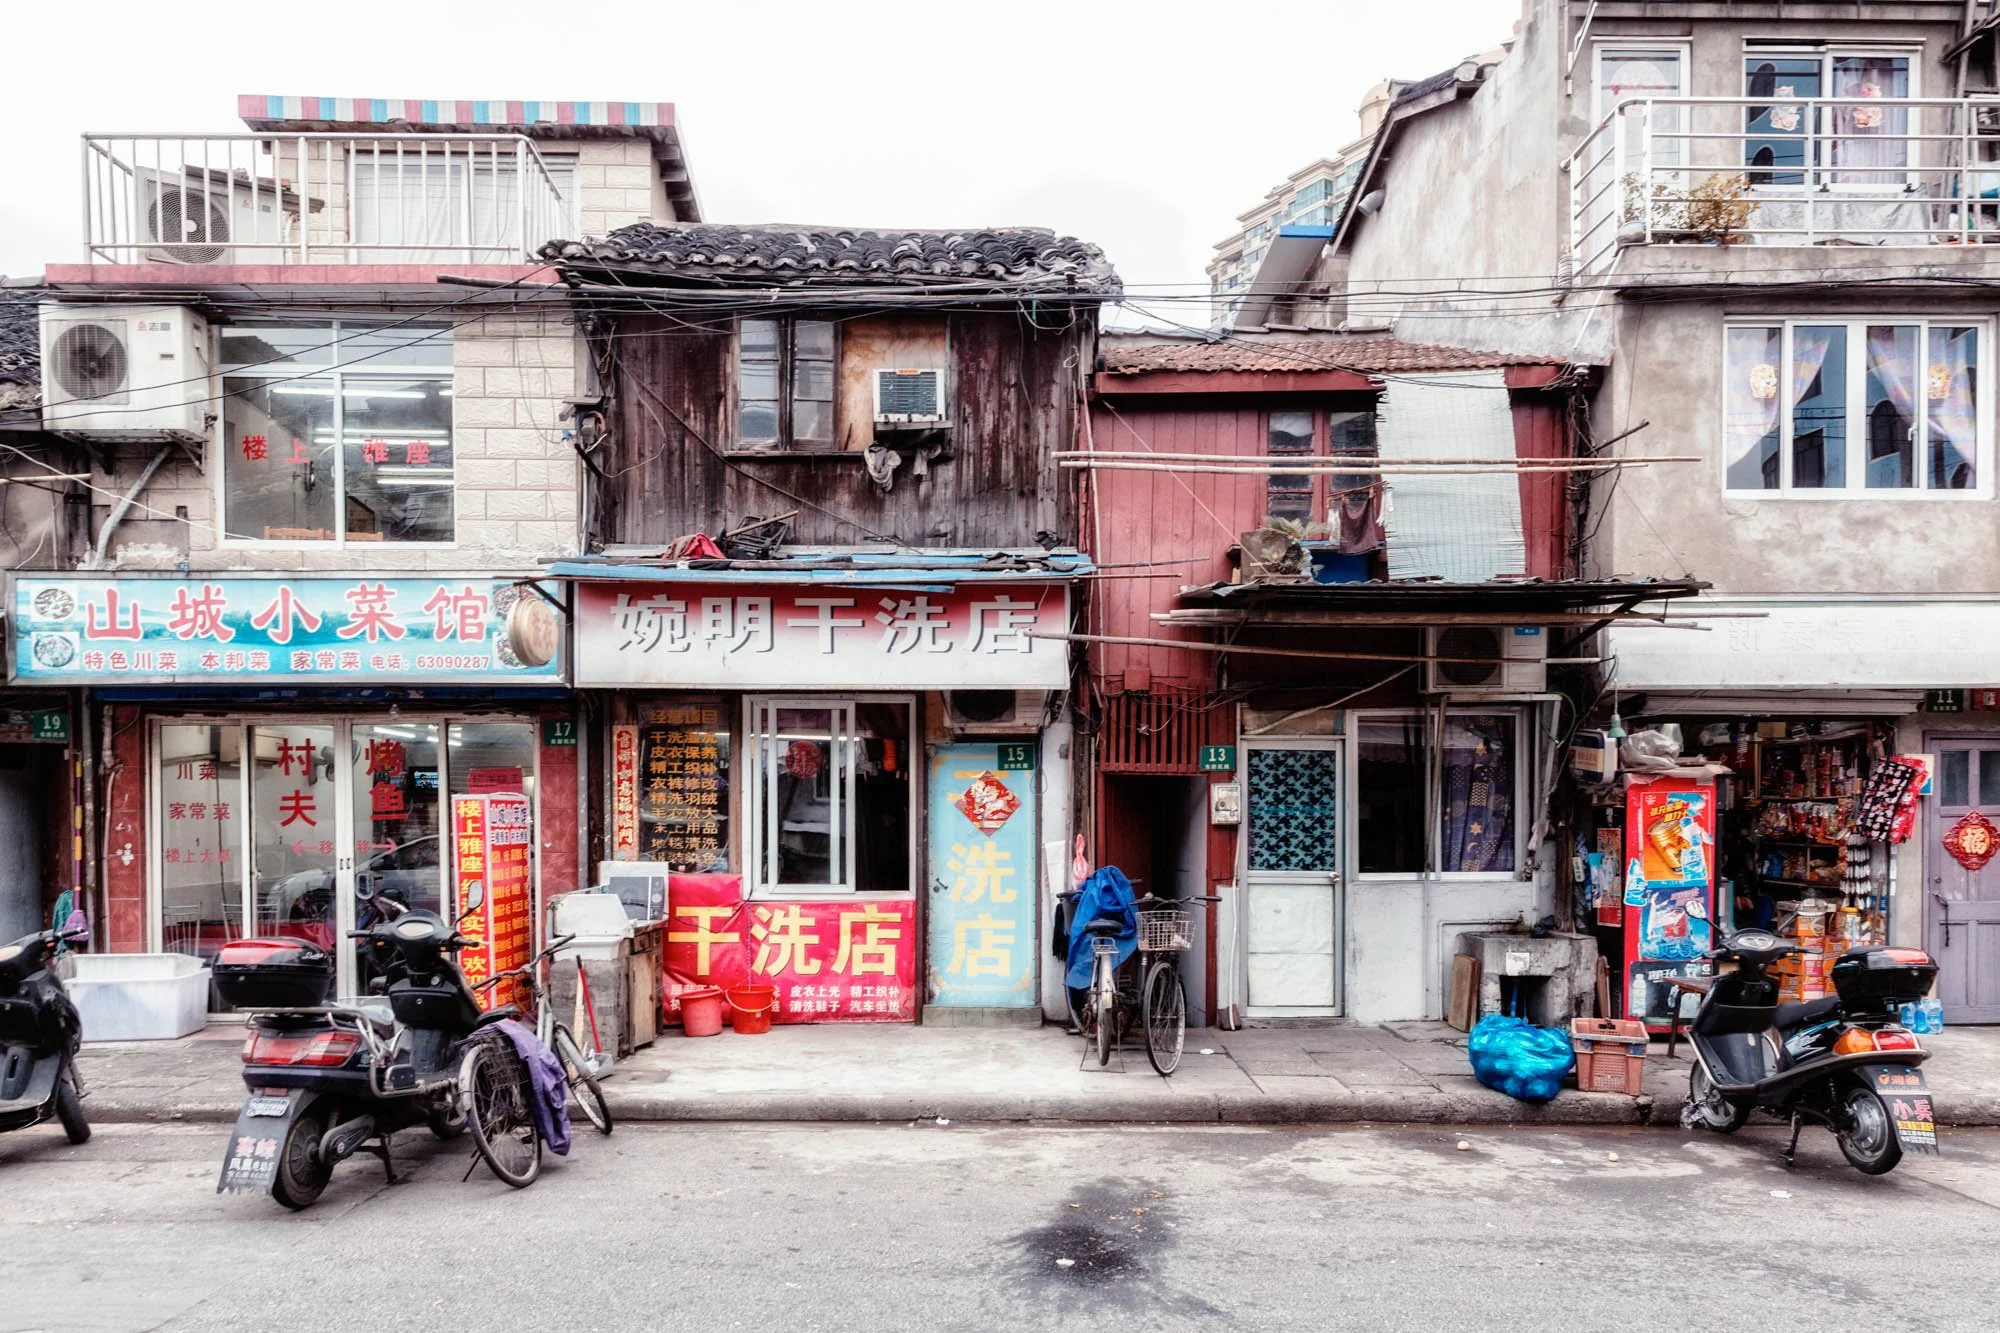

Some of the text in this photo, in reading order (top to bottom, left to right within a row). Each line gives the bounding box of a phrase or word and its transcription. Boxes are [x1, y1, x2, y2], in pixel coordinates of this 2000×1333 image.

[243, 435, 431, 463] 楼上雅座
[86, 584, 488, 643] 山城小菜馆
[610, 593, 1038, 654] 婉明干洗店
[84, 652, 177, 670] 特色川菜
[202, 651, 269, 669] 本邦菜
[290, 651, 360, 669] 家常菜
[417, 655, 489, 669] 63090287
[1937, 689, 1953, 703] 11
[43, 715, 61, 729] 19
[554, 722, 571, 736] 17
[650, 746, 718, 759] 皮衣保养
[1008, 748, 1024, 760] 15
[1208, 748, 1226, 761] 13
[177, 761, 217, 780] 川菜
[650, 761, 718, 775] 精工织补
[277, 738, 317, 827] 村夫
[365, 738, 409, 820] 烤鱼
[650, 777, 718, 790] 衣裤修改
[650, 792, 718, 805] 精洗羽绒
[169, 802, 230, 820] 家常菜
[1961, 827, 1990, 855] 福
[668, 904, 902, 977] 干洗店
[789, 985, 840, 998] 皮衣上光
[850, 985, 900, 998] 精工织补
[789, 1000, 840, 1013] 清洗鞋子
[849, 1000, 900, 1013] 汽车坐垫
[1892, 1099, 1933, 1122] 小兵
